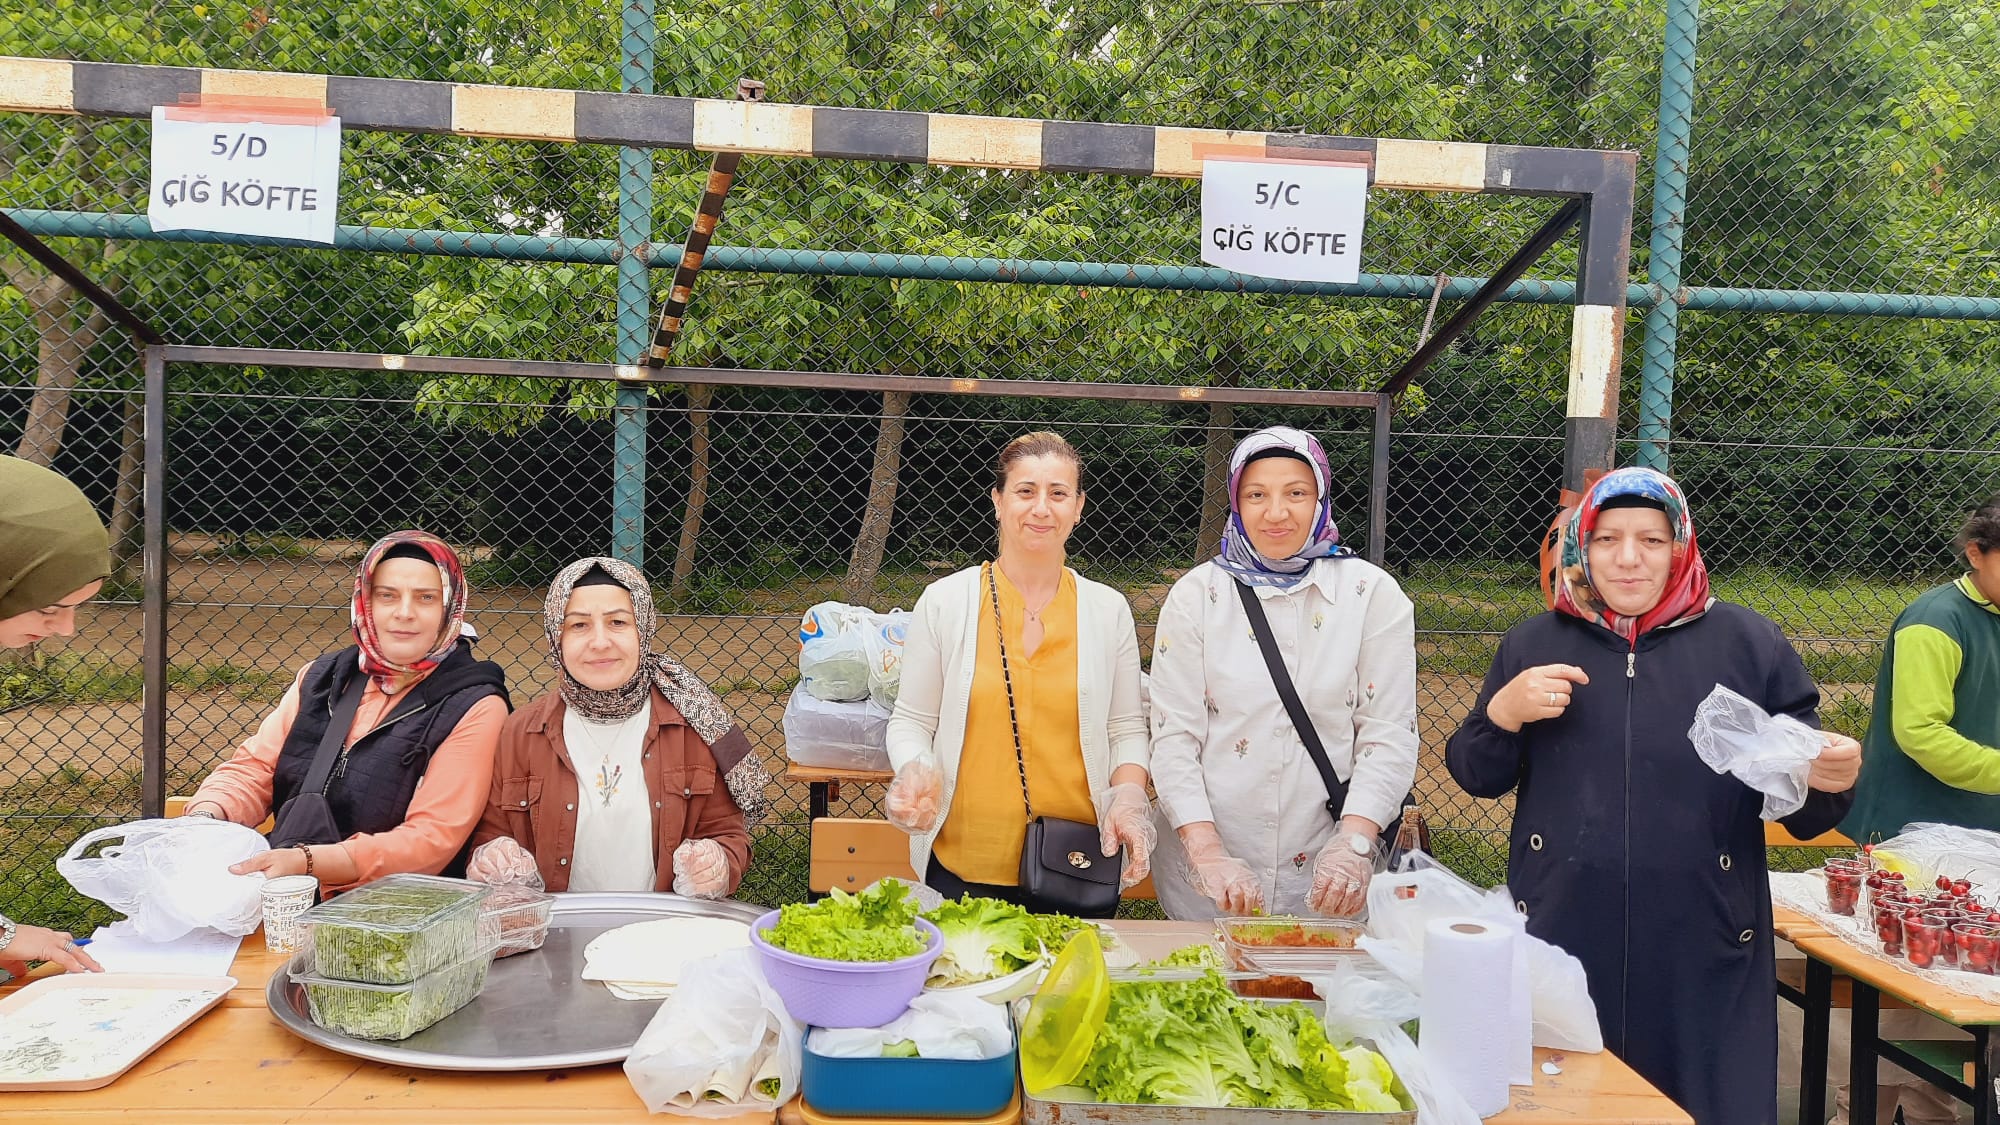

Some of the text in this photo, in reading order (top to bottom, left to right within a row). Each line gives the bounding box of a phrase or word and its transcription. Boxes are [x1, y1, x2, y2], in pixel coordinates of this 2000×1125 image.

[211, 132, 268, 161] 5/D
[161, 174, 318, 212] ÇİĞ KÖFTE
[1255, 180, 1301, 210] 5/C
[1212, 223, 1347, 256] ÇİĞ KÖFTE
